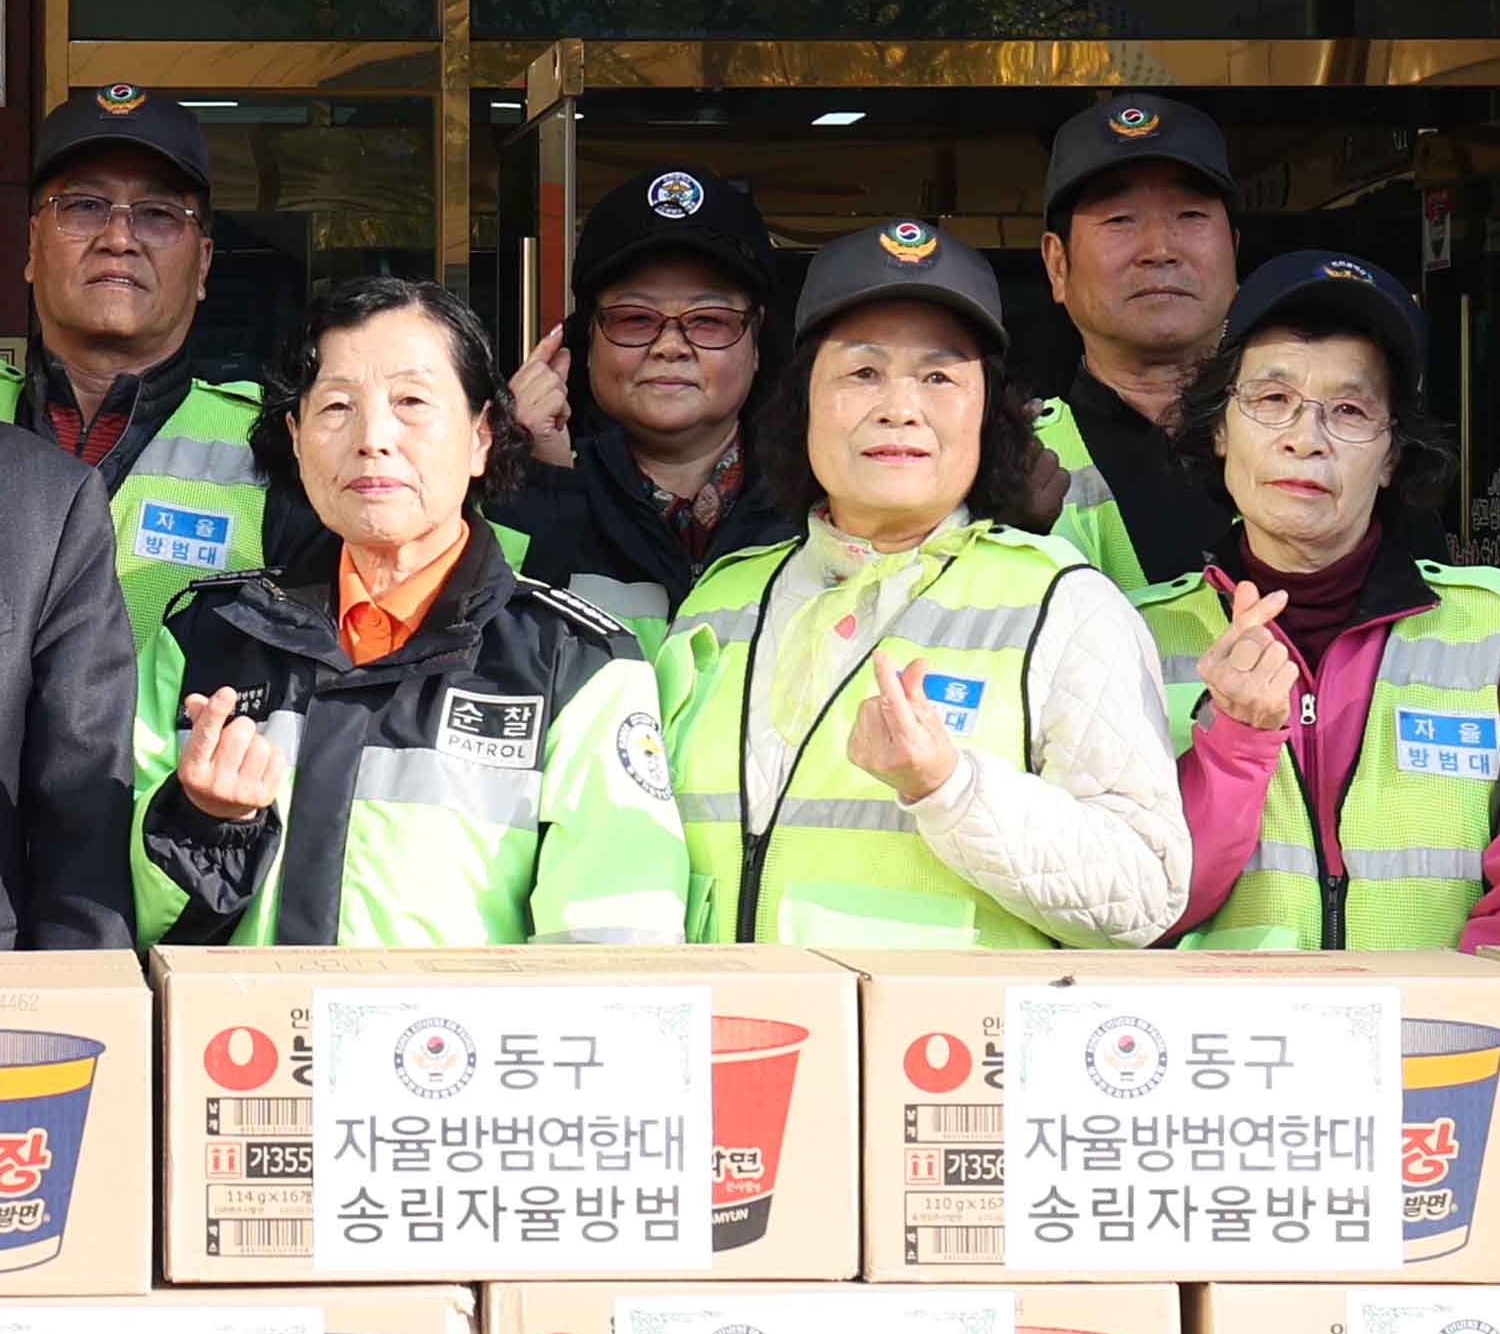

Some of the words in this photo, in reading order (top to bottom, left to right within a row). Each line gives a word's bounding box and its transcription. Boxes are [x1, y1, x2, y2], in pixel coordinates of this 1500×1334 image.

[146, 536, 217, 564] 방범대
[448, 735, 527, 760] PATROL
[1408, 747, 1490, 775] 방범대
[493, 1033, 603, 1092] 동구
[1185, 1032, 1295, 1091] 동구
[333, 1115, 685, 1174] 자율방범연합대
[1023, 1114, 1376, 1174] 자율방범연합대
[336, 1185, 681, 1244] 송림자율방범
[1027, 1184, 1372, 1243] 송림자율방범
